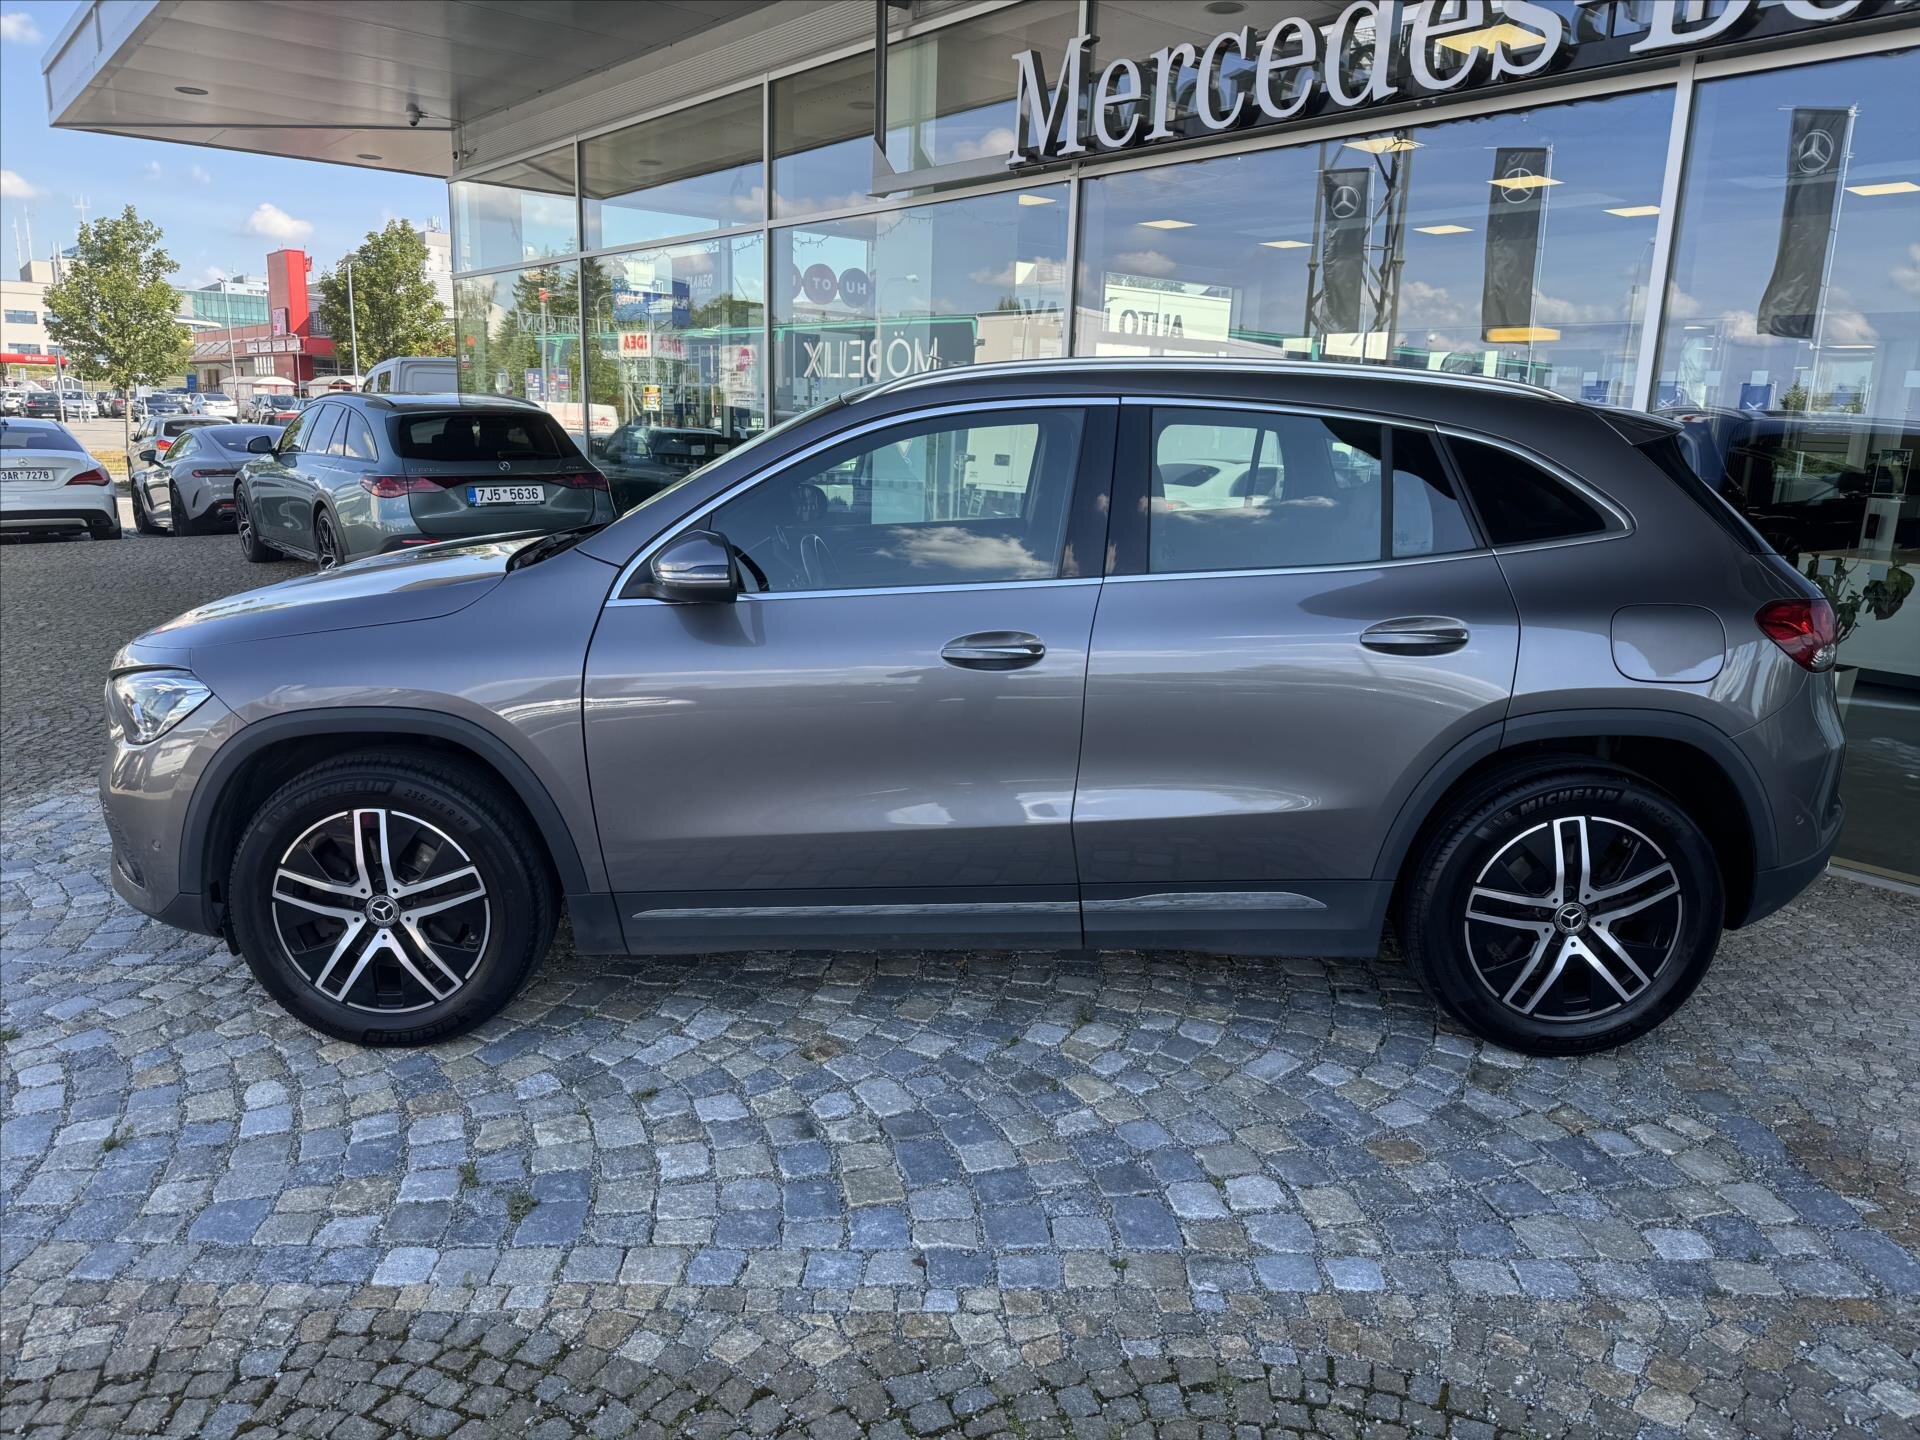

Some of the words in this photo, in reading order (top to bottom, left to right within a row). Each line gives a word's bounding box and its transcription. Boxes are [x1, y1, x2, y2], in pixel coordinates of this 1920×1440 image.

[1, 471, 19, 480] 3AR
[26, 471, 50, 480] 7278
[477, 489, 501, 501] 7J5
[510, 487, 539, 500] 5636
[295, 780, 394, 807] MICHELIN
[1519, 788, 1620, 815] MICHELIN
